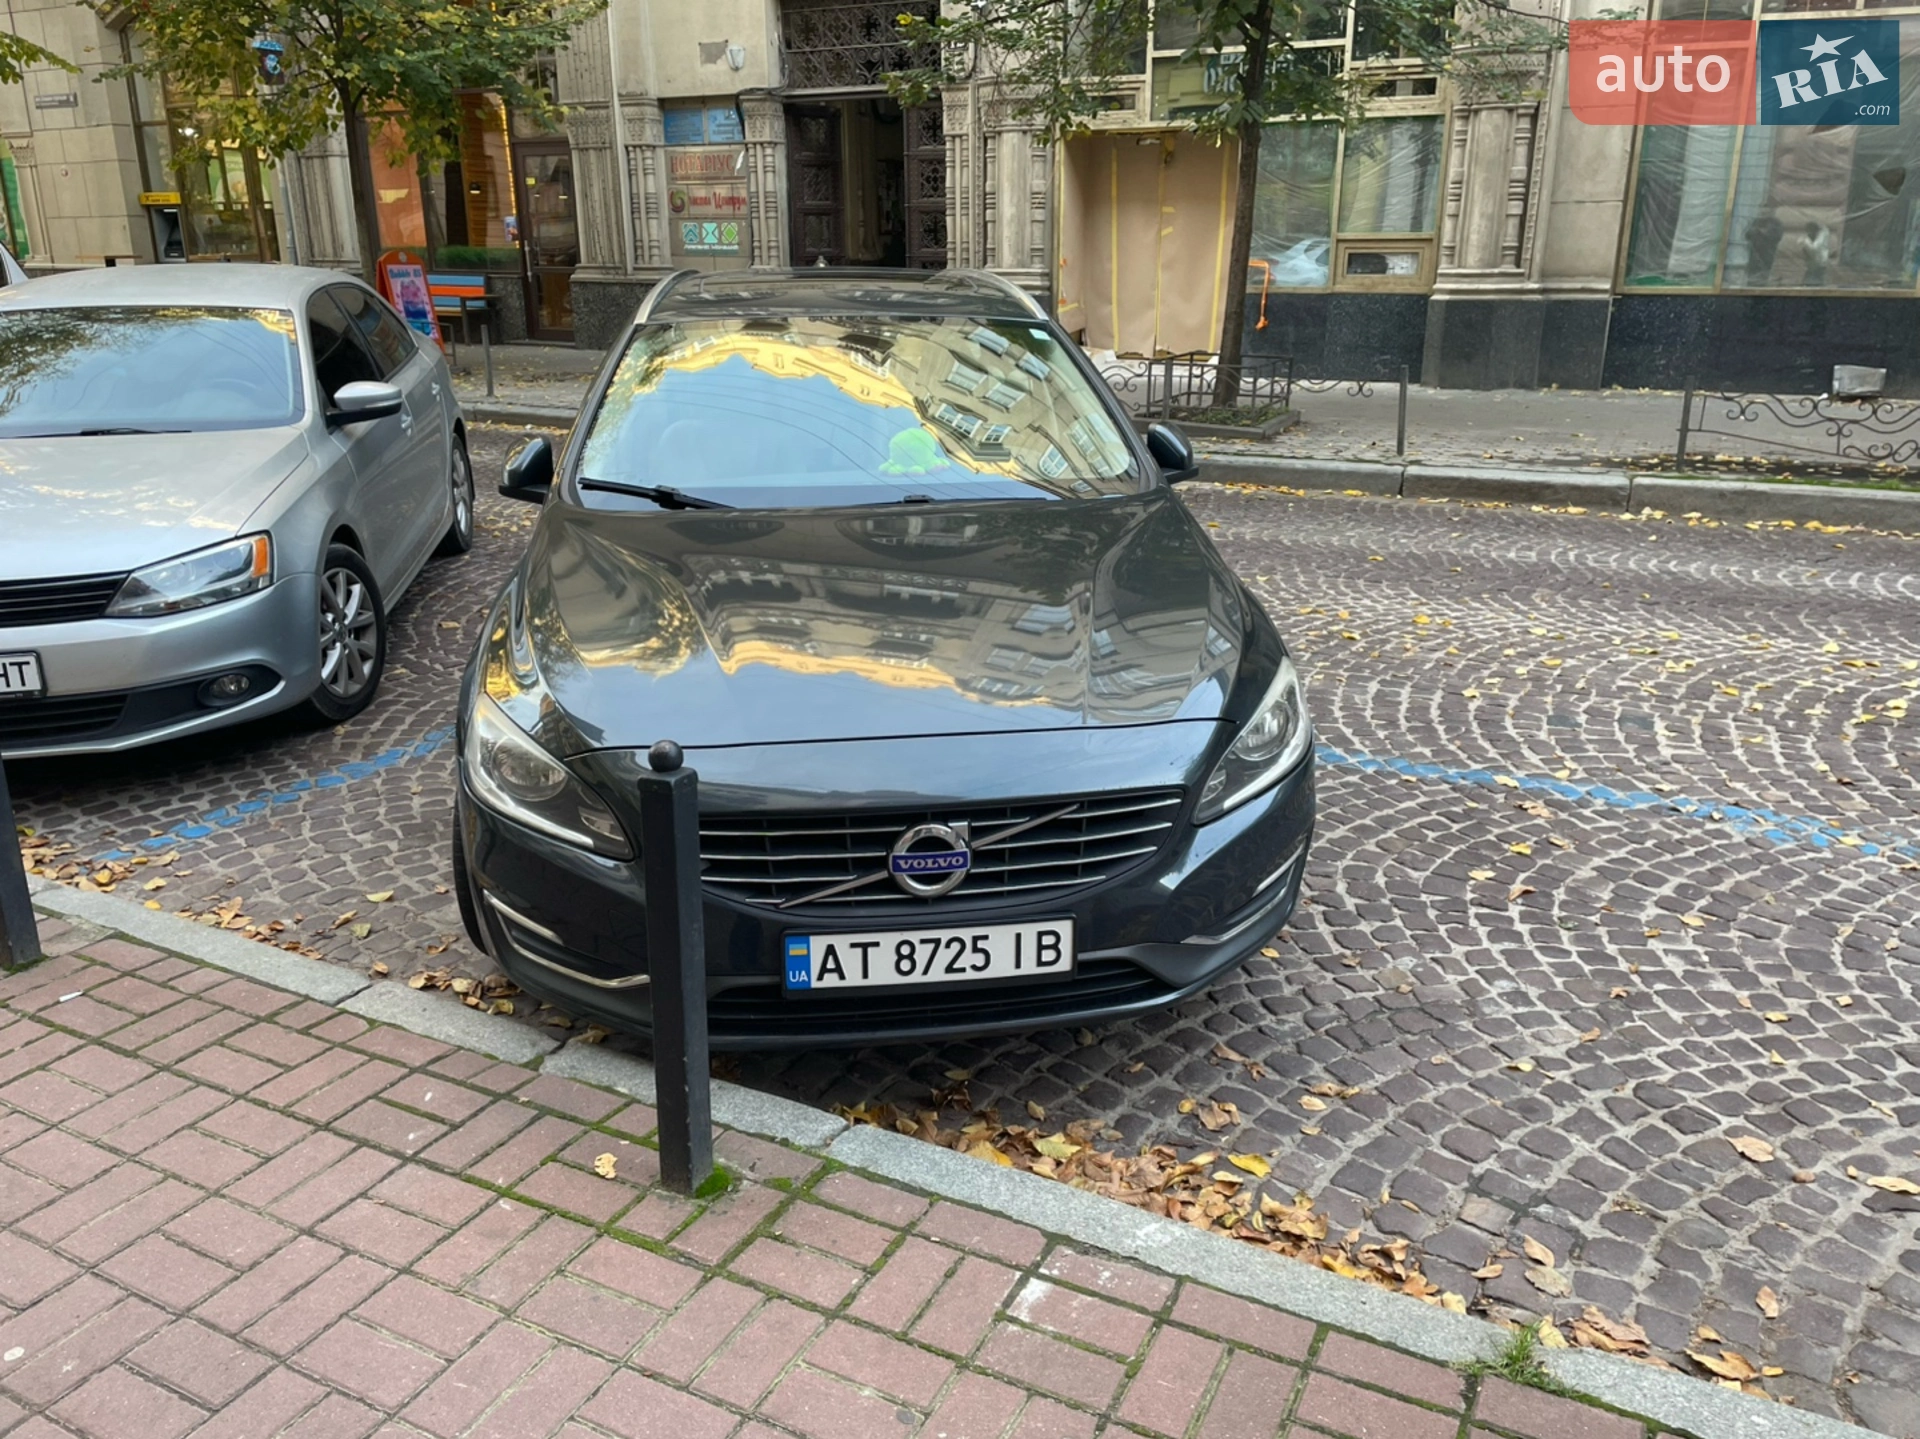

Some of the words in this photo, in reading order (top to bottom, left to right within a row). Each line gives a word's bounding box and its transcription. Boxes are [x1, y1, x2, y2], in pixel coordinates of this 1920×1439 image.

[670, 154, 734, 173] НОТАРІУС
[896, 856, 964, 869] VOLVO
[816, 941, 881, 982] AT
[894, 934, 992, 976] 8725
[1014, 929, 1062, 969] IB
[789, 970, 809, 983] UA
